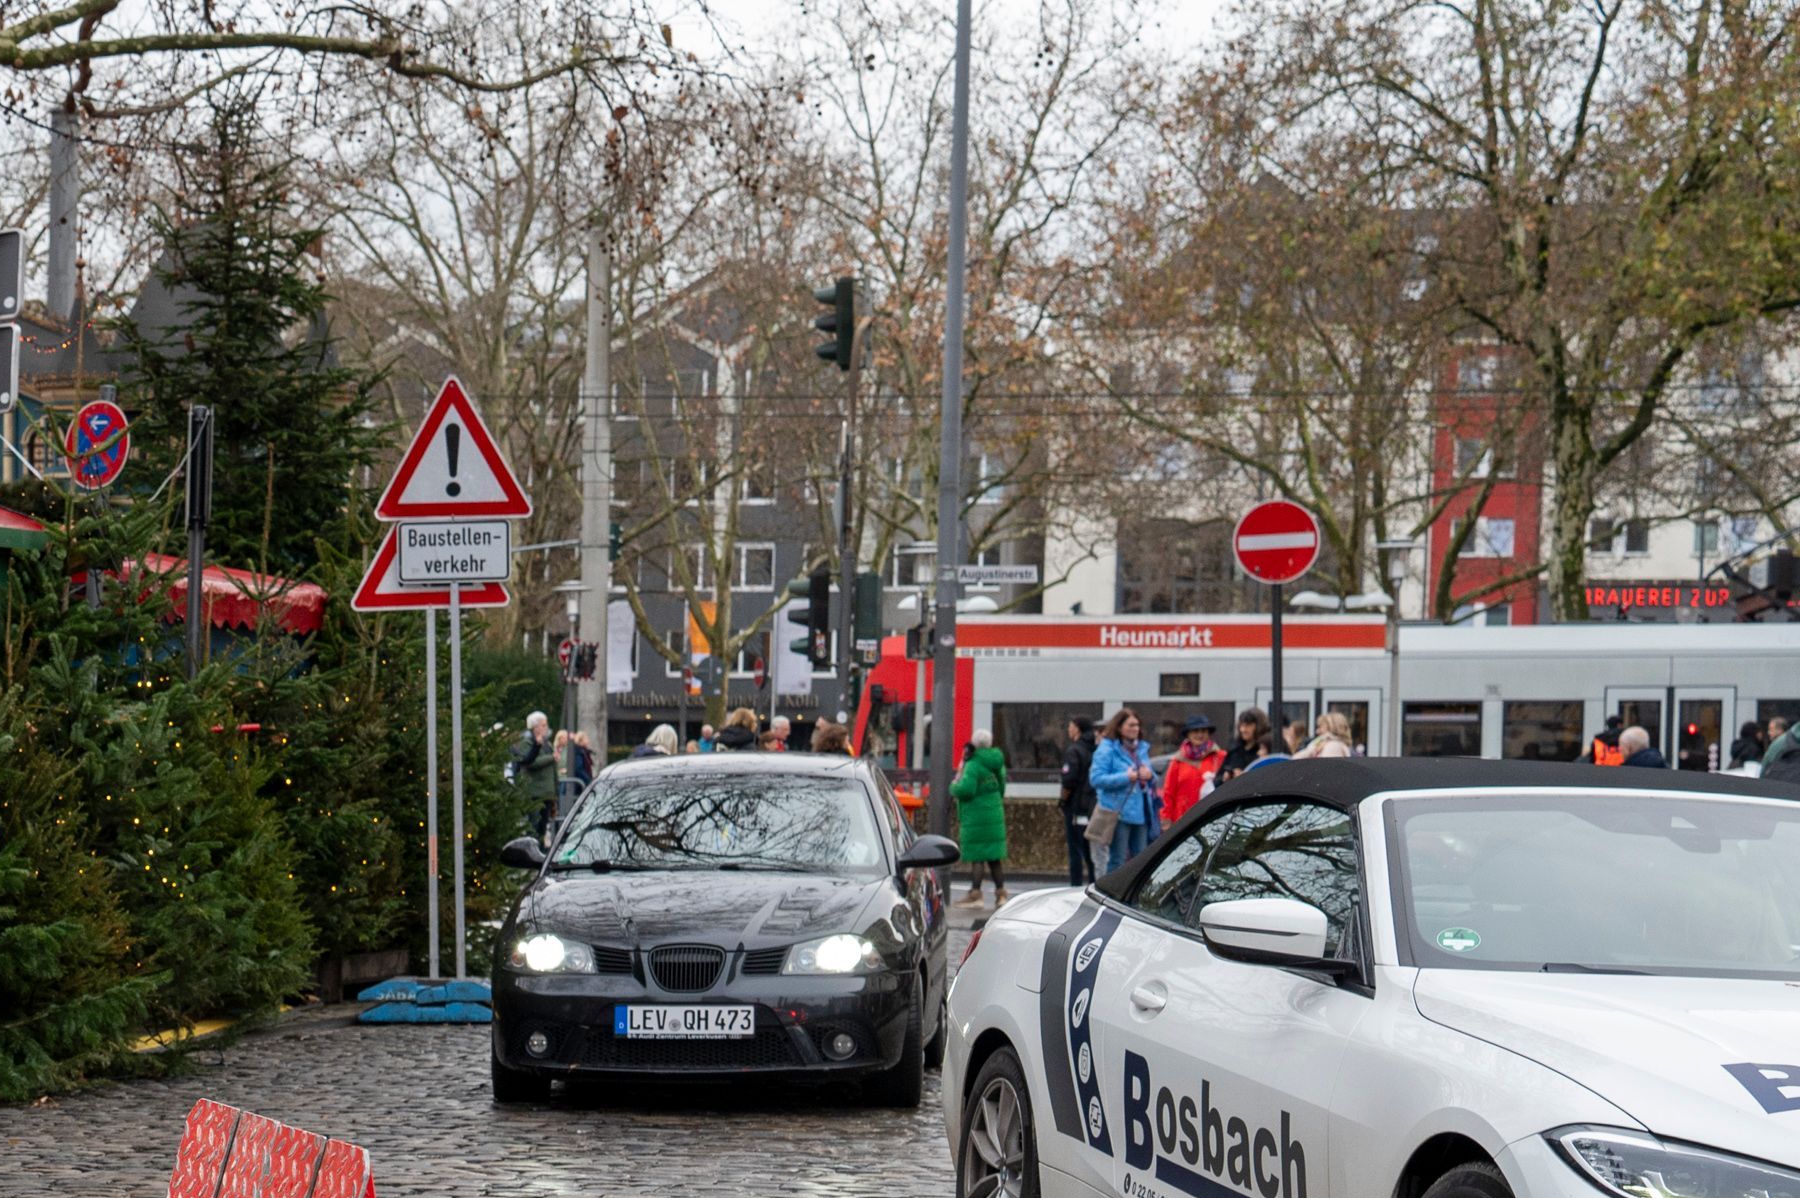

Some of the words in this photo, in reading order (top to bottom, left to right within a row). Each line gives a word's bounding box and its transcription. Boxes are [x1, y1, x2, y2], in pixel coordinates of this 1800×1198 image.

[408, 527, 501, 547] Baustellen-
[424, 554, 486, 573] verkehr
[1100, 625, 1213, 647] Heumarkt
[629, 1009, 667, 1030] LEV
[683, 1009, 709, 1030] QH
[715, 1009, 752, 1030] 473
